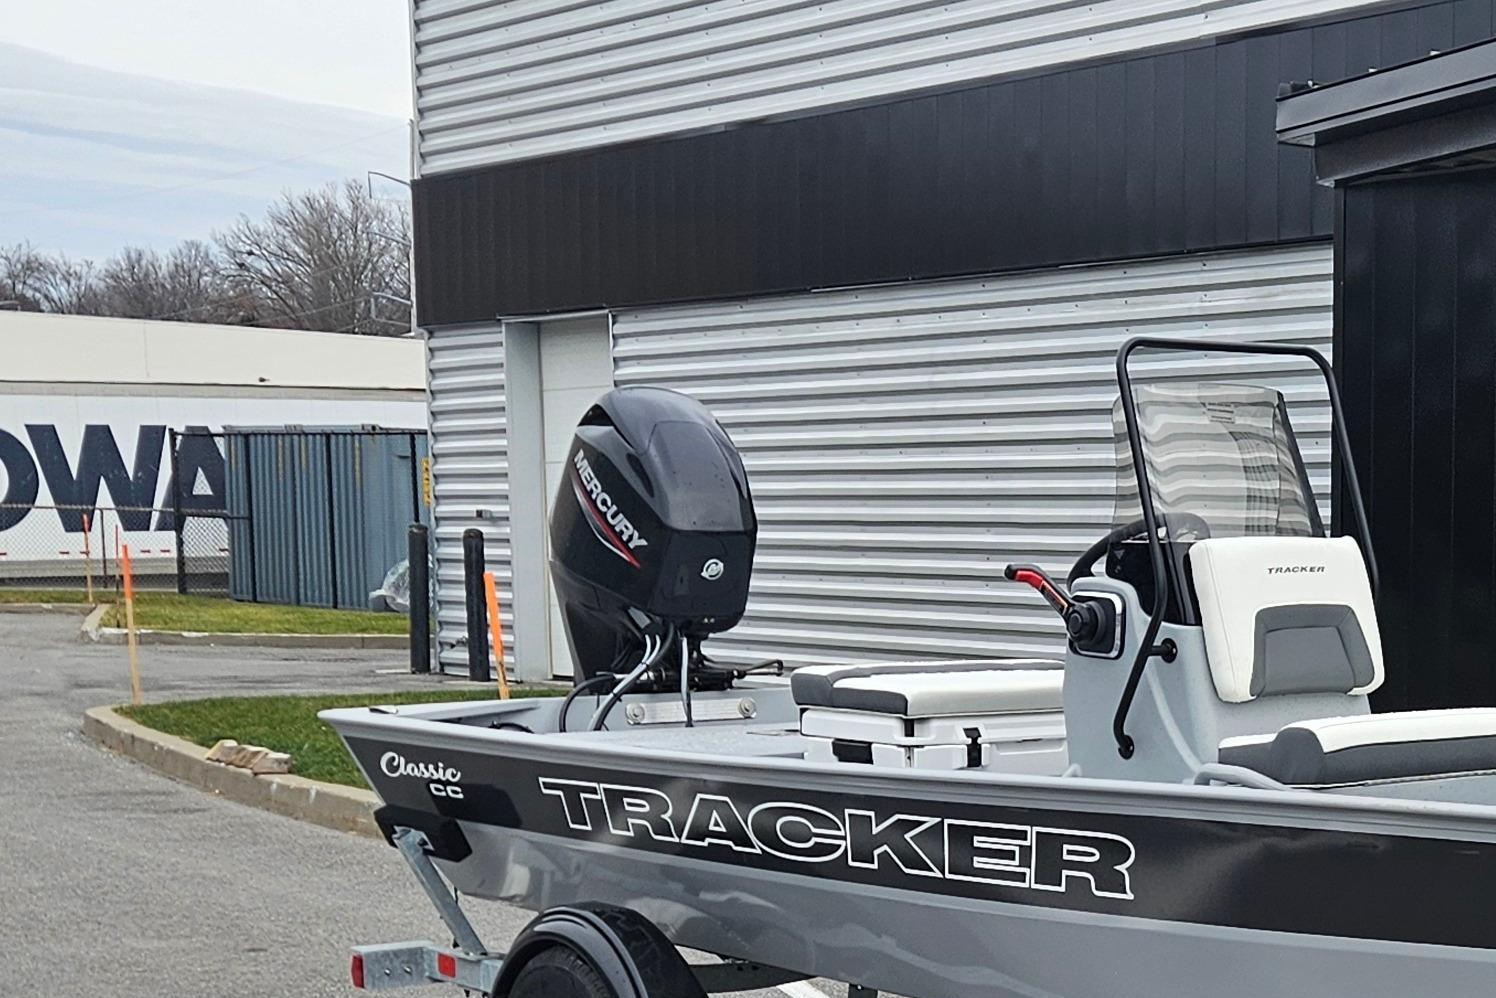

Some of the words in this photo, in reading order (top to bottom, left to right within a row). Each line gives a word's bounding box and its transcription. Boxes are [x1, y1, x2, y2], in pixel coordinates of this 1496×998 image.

[574, 449, 648, 549] MERCURY
[1267, 566, 1325, 574] TRACKER
[380, 751, 461, 782] Classic
[429, 783, 464, 799] CC
[539, 777, 1136, 900] TRACKER
